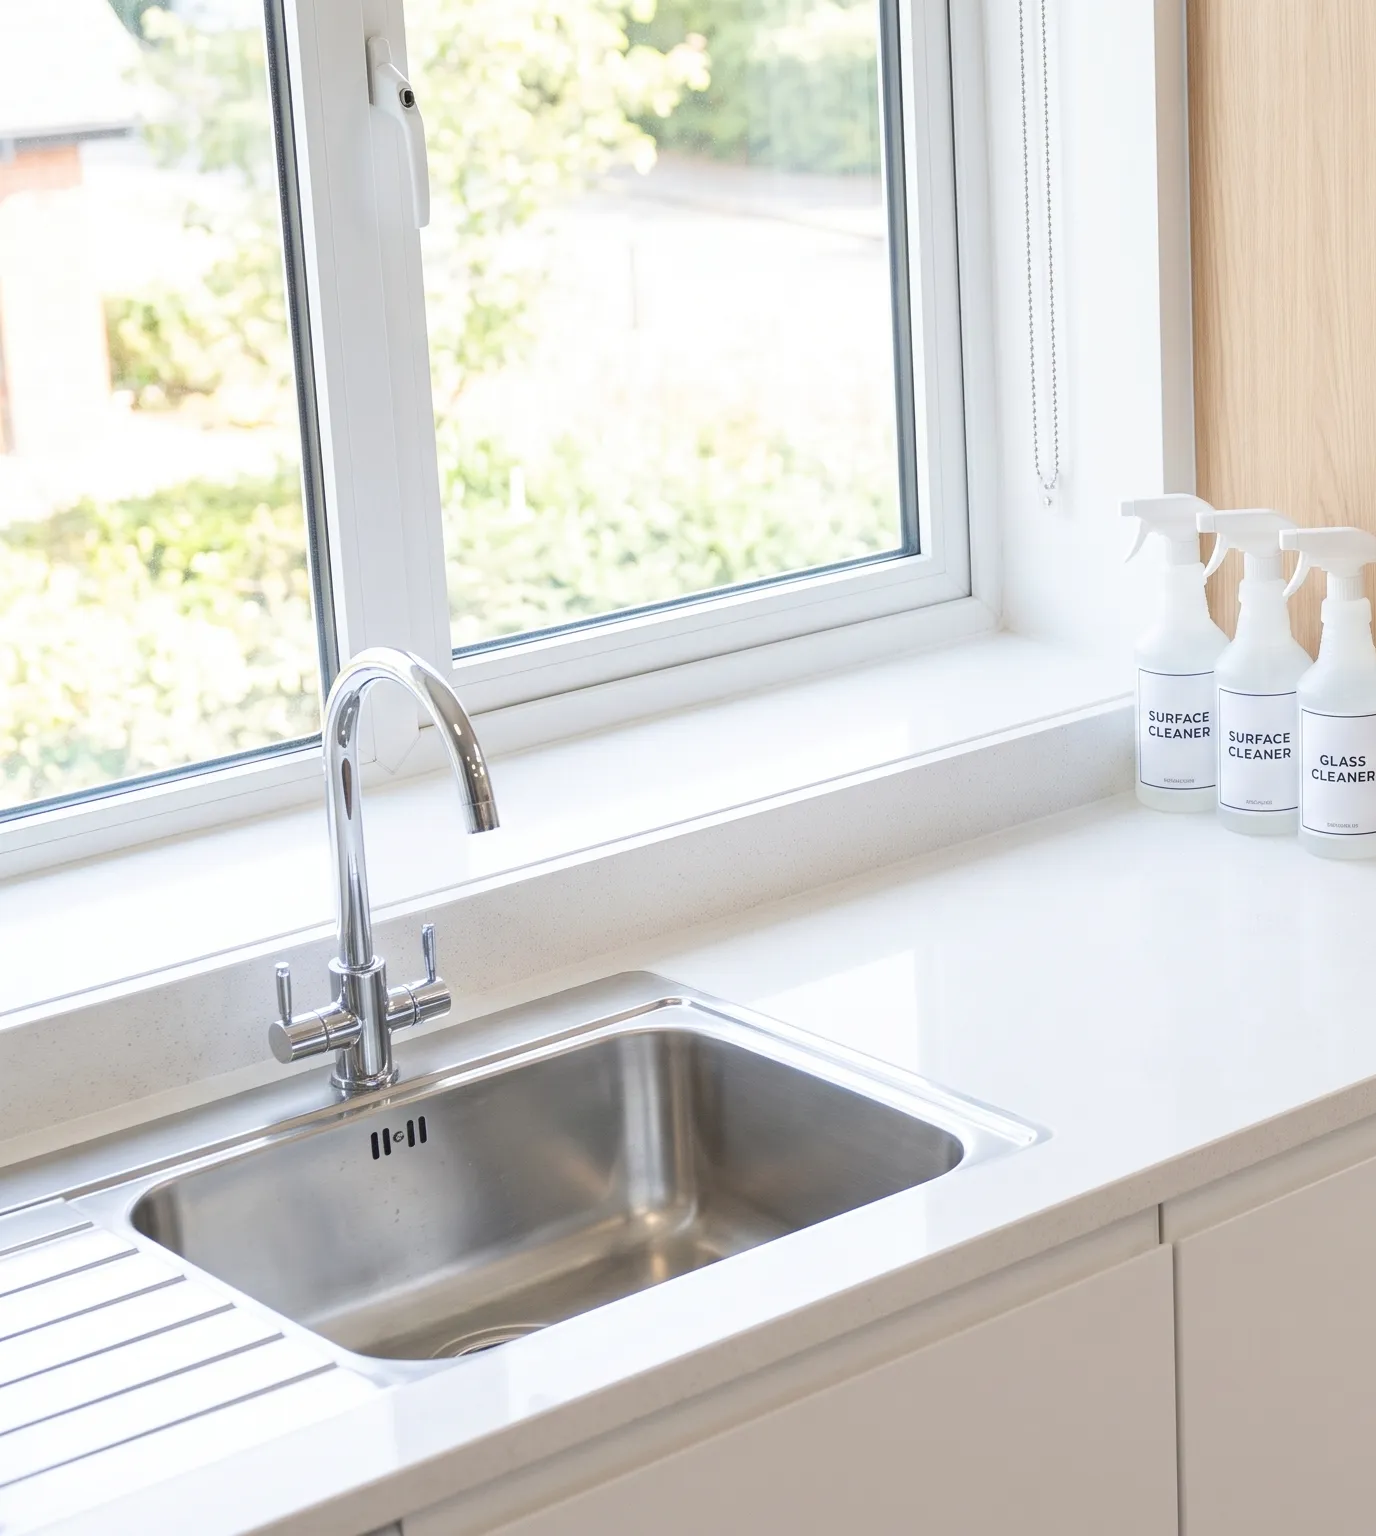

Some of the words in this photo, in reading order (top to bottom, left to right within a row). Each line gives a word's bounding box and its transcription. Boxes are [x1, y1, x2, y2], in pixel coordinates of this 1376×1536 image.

[1148, 710, 1210, 724] SURFACE
[1148, 725, 1211, 739] CLEANER
[1228, 730, 1291, 745] SURFACE
[1228, 746, 1292, 760] CLEANER
[1319, 754, 1367, 768] GLASS
[1311, 768, 1376, 783] CLEANER
